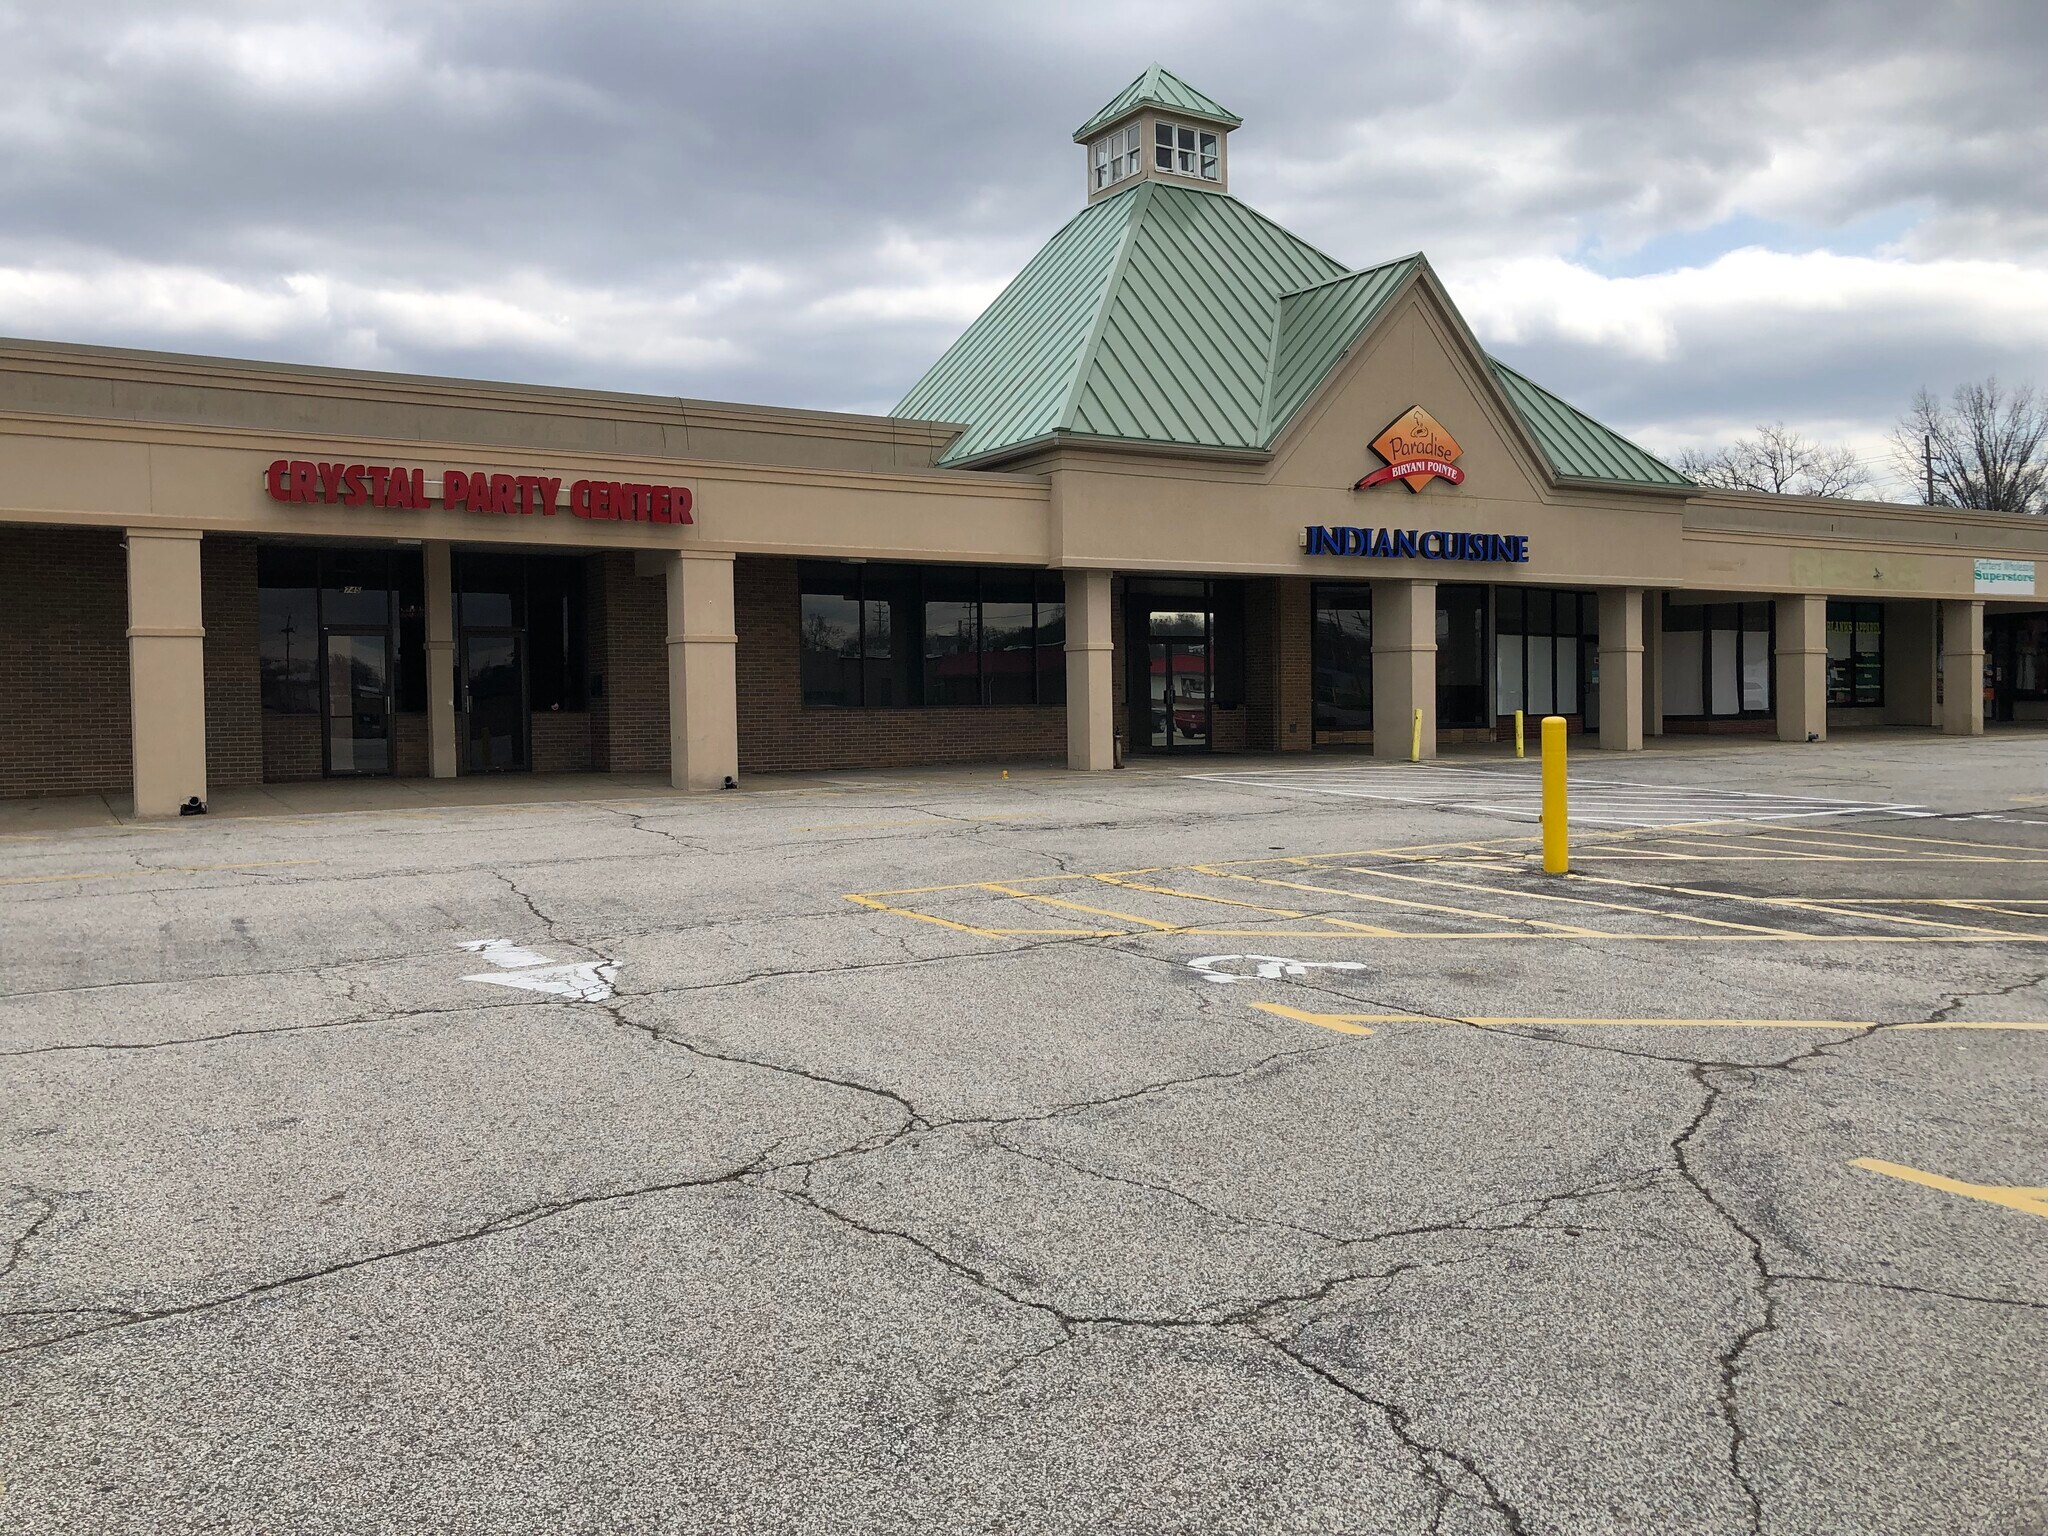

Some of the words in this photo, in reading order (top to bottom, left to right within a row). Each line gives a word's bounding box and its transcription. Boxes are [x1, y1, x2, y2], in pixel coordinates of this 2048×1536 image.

[1389, 432, 1452, 462] Paradise
[1391, 461, 1425, 478] BIRYANI
[1427, 461, 1458, 480] POINTE
[267, 459, 431, 509] CRYSTAL
[443, 469, 562, 517] PARTY
[570, 479, 694, 525] CENTER
[1304, 525, 1419, 559] INDIAN
[1418, 530, 1530, 563] CUISINE
[1974, 569, 2036, 583] Superstore
